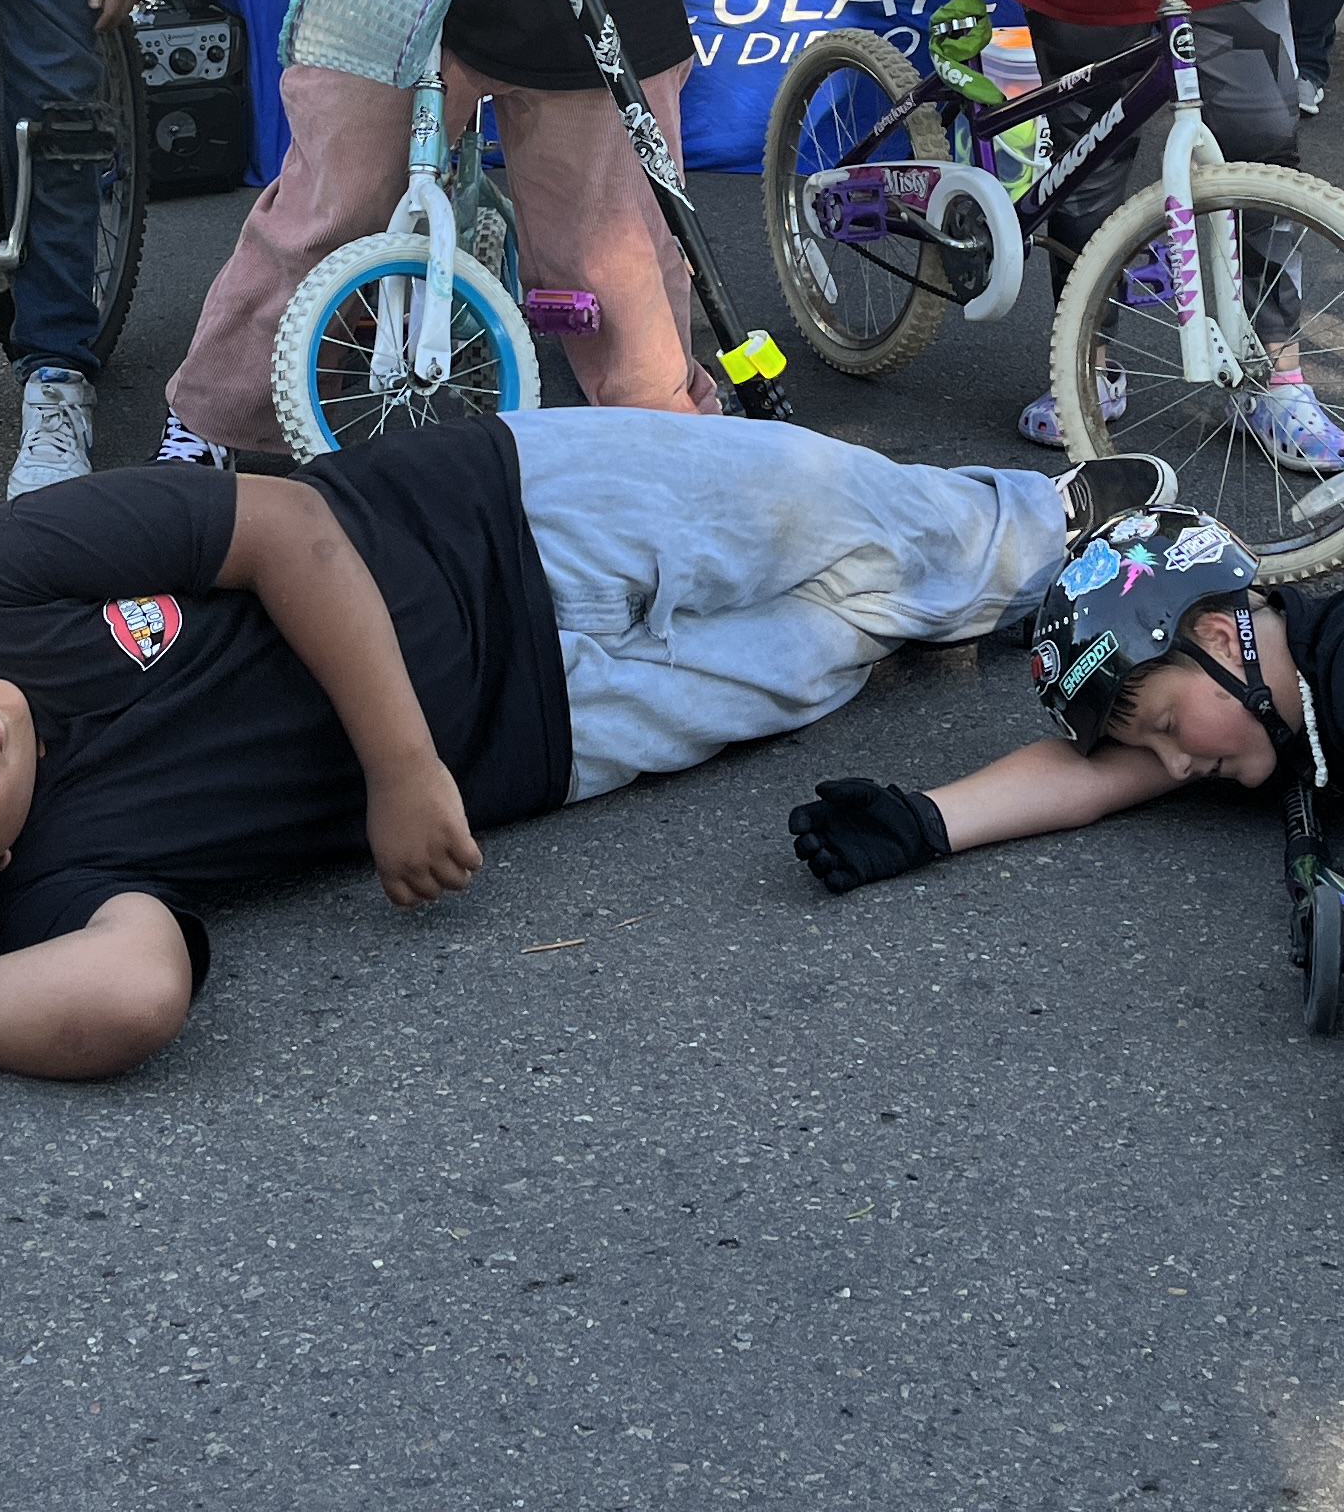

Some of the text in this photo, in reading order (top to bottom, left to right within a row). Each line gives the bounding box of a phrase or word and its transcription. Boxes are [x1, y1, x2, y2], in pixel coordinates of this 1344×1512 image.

[1038, 97, 1125, 205] MAGNA
[882, 168, 930, 200] Misty
[1063, 636, 1111, 695] SHREDDY
